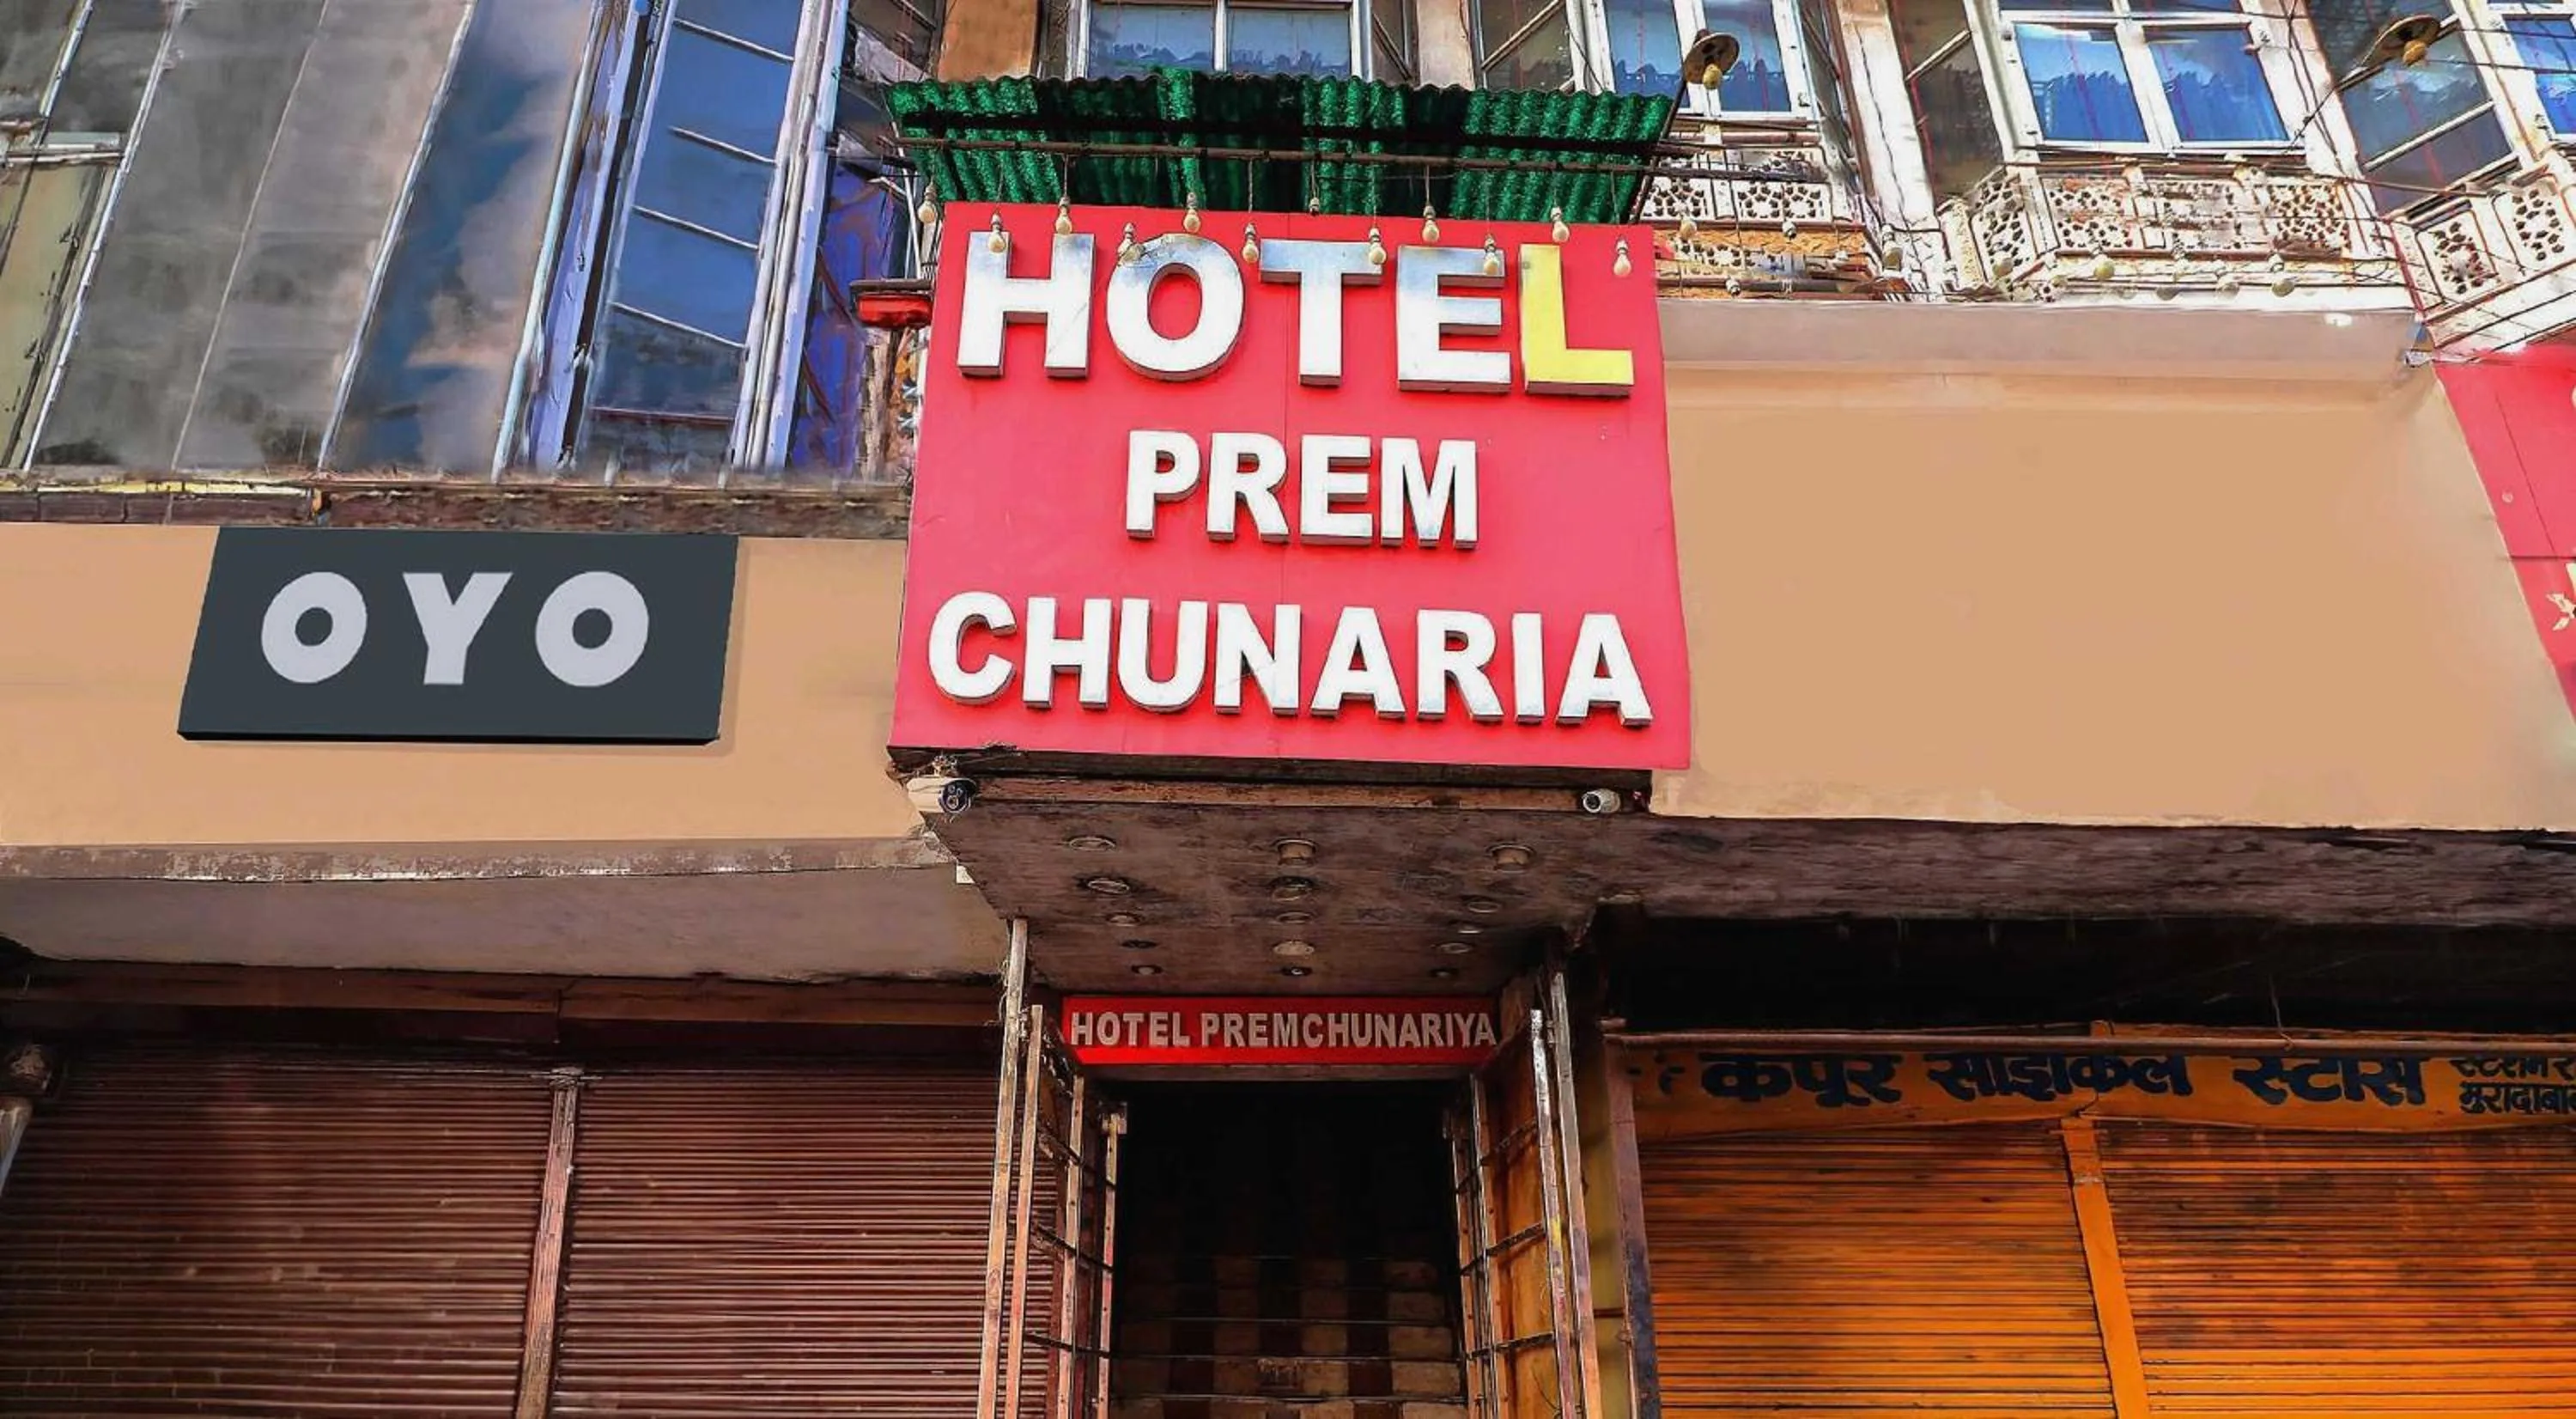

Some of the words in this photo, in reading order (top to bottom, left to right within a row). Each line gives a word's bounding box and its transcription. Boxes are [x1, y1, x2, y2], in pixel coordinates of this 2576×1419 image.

[957, 231, 1634, 397] HOTEL
[1126, 430, 1478, 550] PREM
[261, 571, 649, 687] OYO
[928, 592, 1653, 728] CHUNARIA
[1071, 1011, 1190, 1047] HOTEL
[1202, 1012, 1498, 1048] PREMCHUNARIYA
[1698, 1051, 1904, 1108] कपूर
